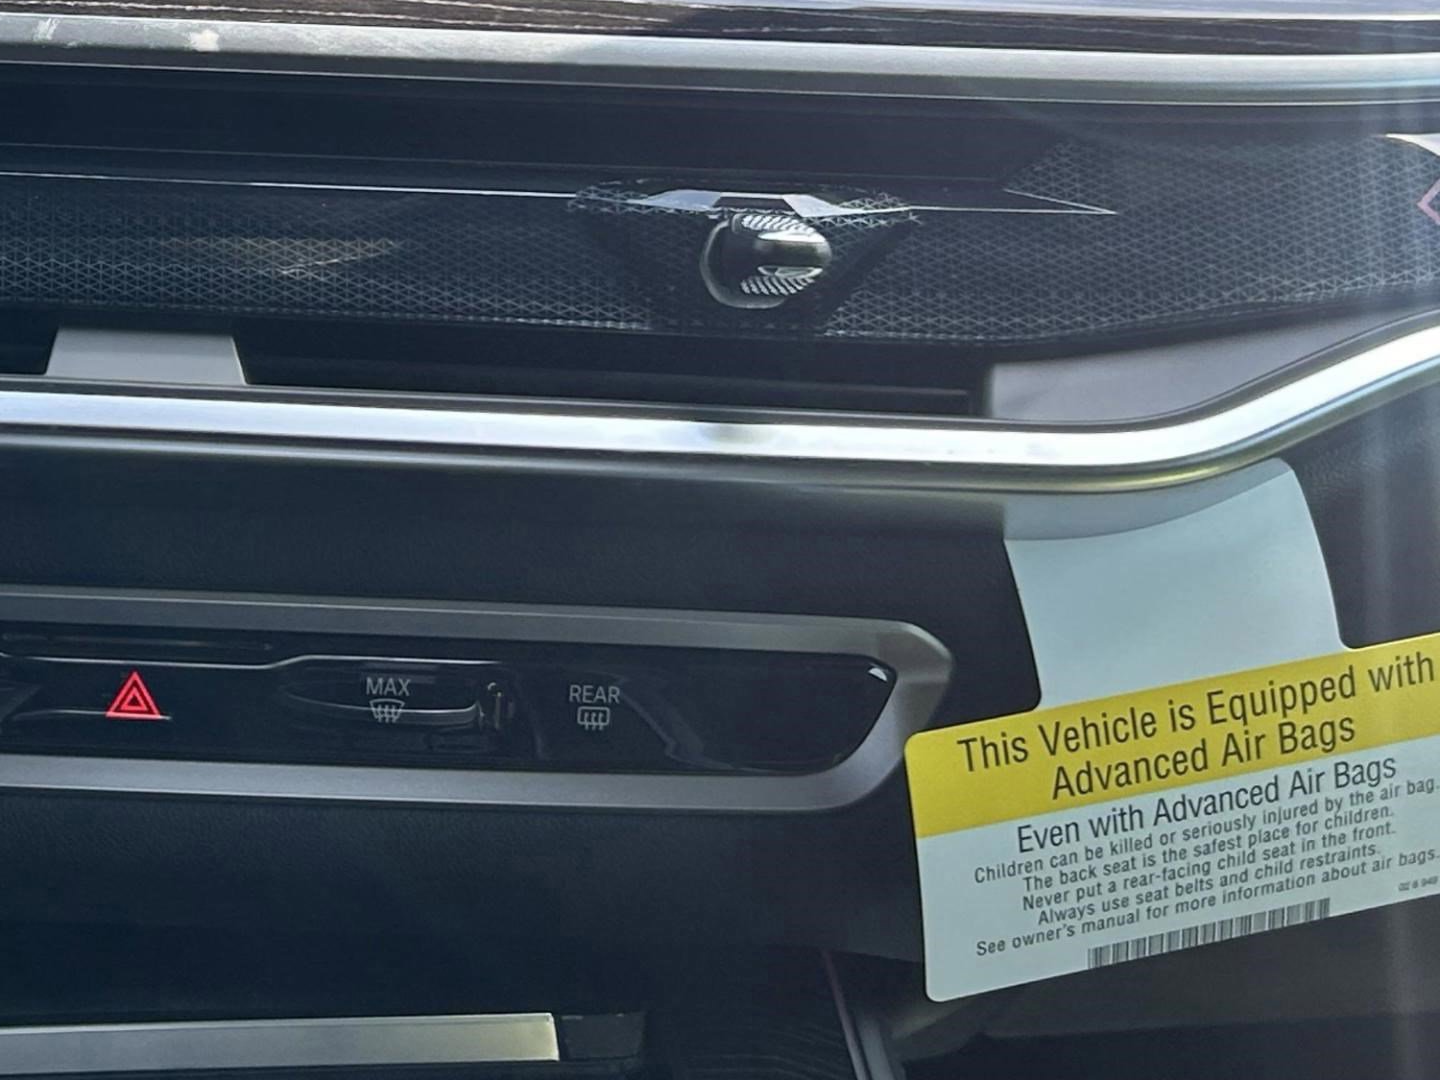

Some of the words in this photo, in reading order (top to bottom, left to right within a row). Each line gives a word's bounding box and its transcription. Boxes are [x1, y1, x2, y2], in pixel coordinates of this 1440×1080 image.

[365, 676, 411, 697] MAX
[568, 684, 621, 704] REAR
[957, 732, 1029, 772] This
[1038, 707, 1157, 756] Vehicle
[1168, 700, 1196, 732] is
[1207, 665, 1356, 726] Equipped
[1368, 651, 1435, 693] with
[1052, 738, 1209, 800] Advanced
[1221, 730, 1266, 767] Air
[1278, 717, 1355, 754] Bags
[974, 857, 1044, 884] Children
[1049, 851, 1079, 869] can
[1084, 846, 1104, 862] be
[1110, 833, 1153, 857] killed
[1159, 832, 1177, 846] or
[1182, 813, 1257, 842] seriously
[1262, 799, 1319, 825] injured
[1324, 795, 1344, 814] by
[1349, 790, 1374, 806] the
[1379, 784, 1401, 800] air
[1406, 777, 1440, 797] bag.
[1017, 821, 1081, 854] Even
[1088, 804, 1144, 838] with
[1153, 774, 1280, 826] Advanced
[1288, 768, 1325, 799] Air
[1334, 757, 1397, 789] Bags
[1022, 873, 1053, 892] The
[1060, 865, 1099, 885] back
[1103, 857, 1137, 876] seat
[1142, 852, 1157, 869] is
[1162, 845, 1188, 863] the
[1193, 835, 1242, 858] safest
[1248, 827, 1290, 848] place
[1295, 819, 1320, 836] for
[1324, 805, 1395, 831] children.
[976, 939, 1006, 956] See
[1012, 923, 1076, 949] owner's
[1081, 909, 1141, 935] manual
[1146, 904, 1170, 920] for
[1175, 892, 1217, 911] more
[1222, 873, 1316, 905] information
[1321, 859, 1367, 884] about
[1372, 856, 1393, 873] air
[1398, 847, 1440, 867] bags.
[1022, 890, 1070, 911] Never
[1076, 882, 1103, 903] put
[1107, 881, 1117, 894] a
[1123, 860, 1211, 890] rear-facing
[1217, 849, 1257, 870] child
[1262, 841, 1296, 861] seat
[1301, 837, 1316, 853] in
[1321, 831, 1347, 848] the
[1352, 821, 1397, 843] front.
[1038, 901, 1095, 926] Always
[1101, 896, 1130, 913] use
[1135, 886, 1170, 905] seat
[1174, 874, 1214, 897] belts
[1219, 870, 1249, 888] and
[1254, 859, 1293, 880] child
